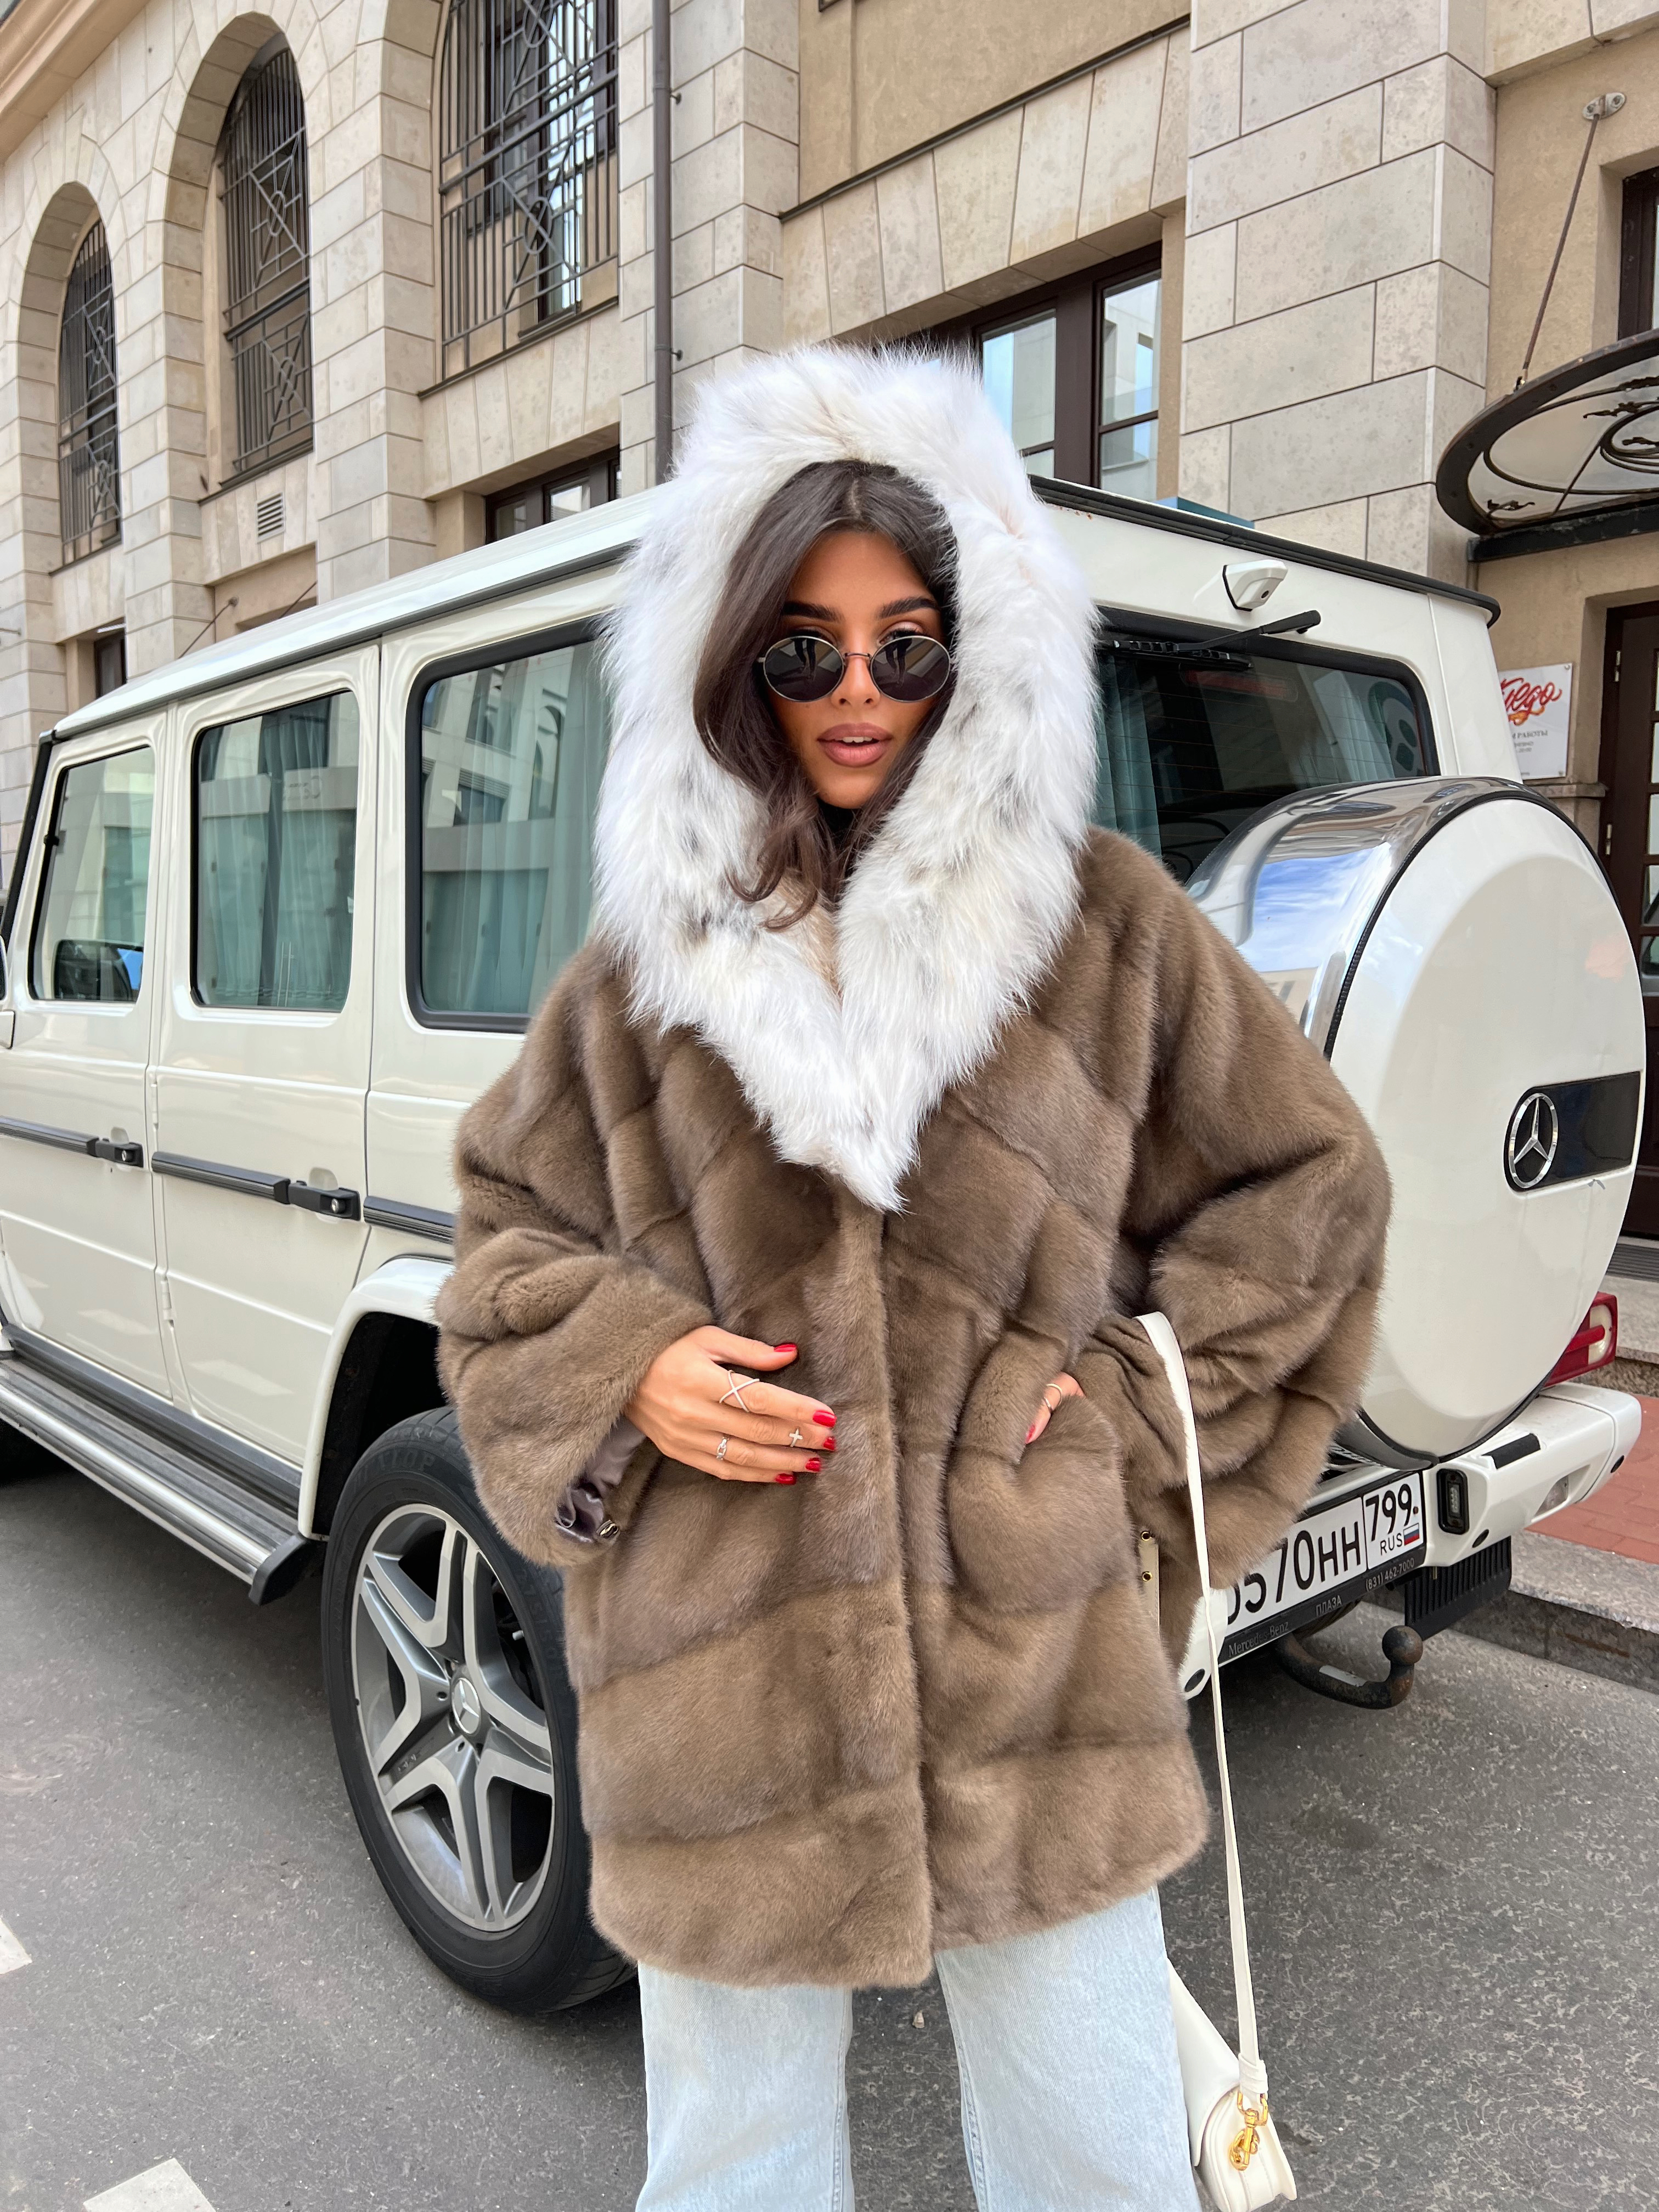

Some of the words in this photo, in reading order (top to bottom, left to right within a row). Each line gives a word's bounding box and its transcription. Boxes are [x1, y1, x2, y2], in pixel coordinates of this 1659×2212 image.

[1365, 1483, 1412, 1542] 799
[1380, 1533, 1403, 1556] RUS
[1228, 1621, 1289, 1658] Mercedes-Benz
[1316, 1595, 1342, 1617] ПЛАЗА
[1365, 1572, 1384, 1592] (831)
[1385, 1558, 1414, 1581] 462-7000
